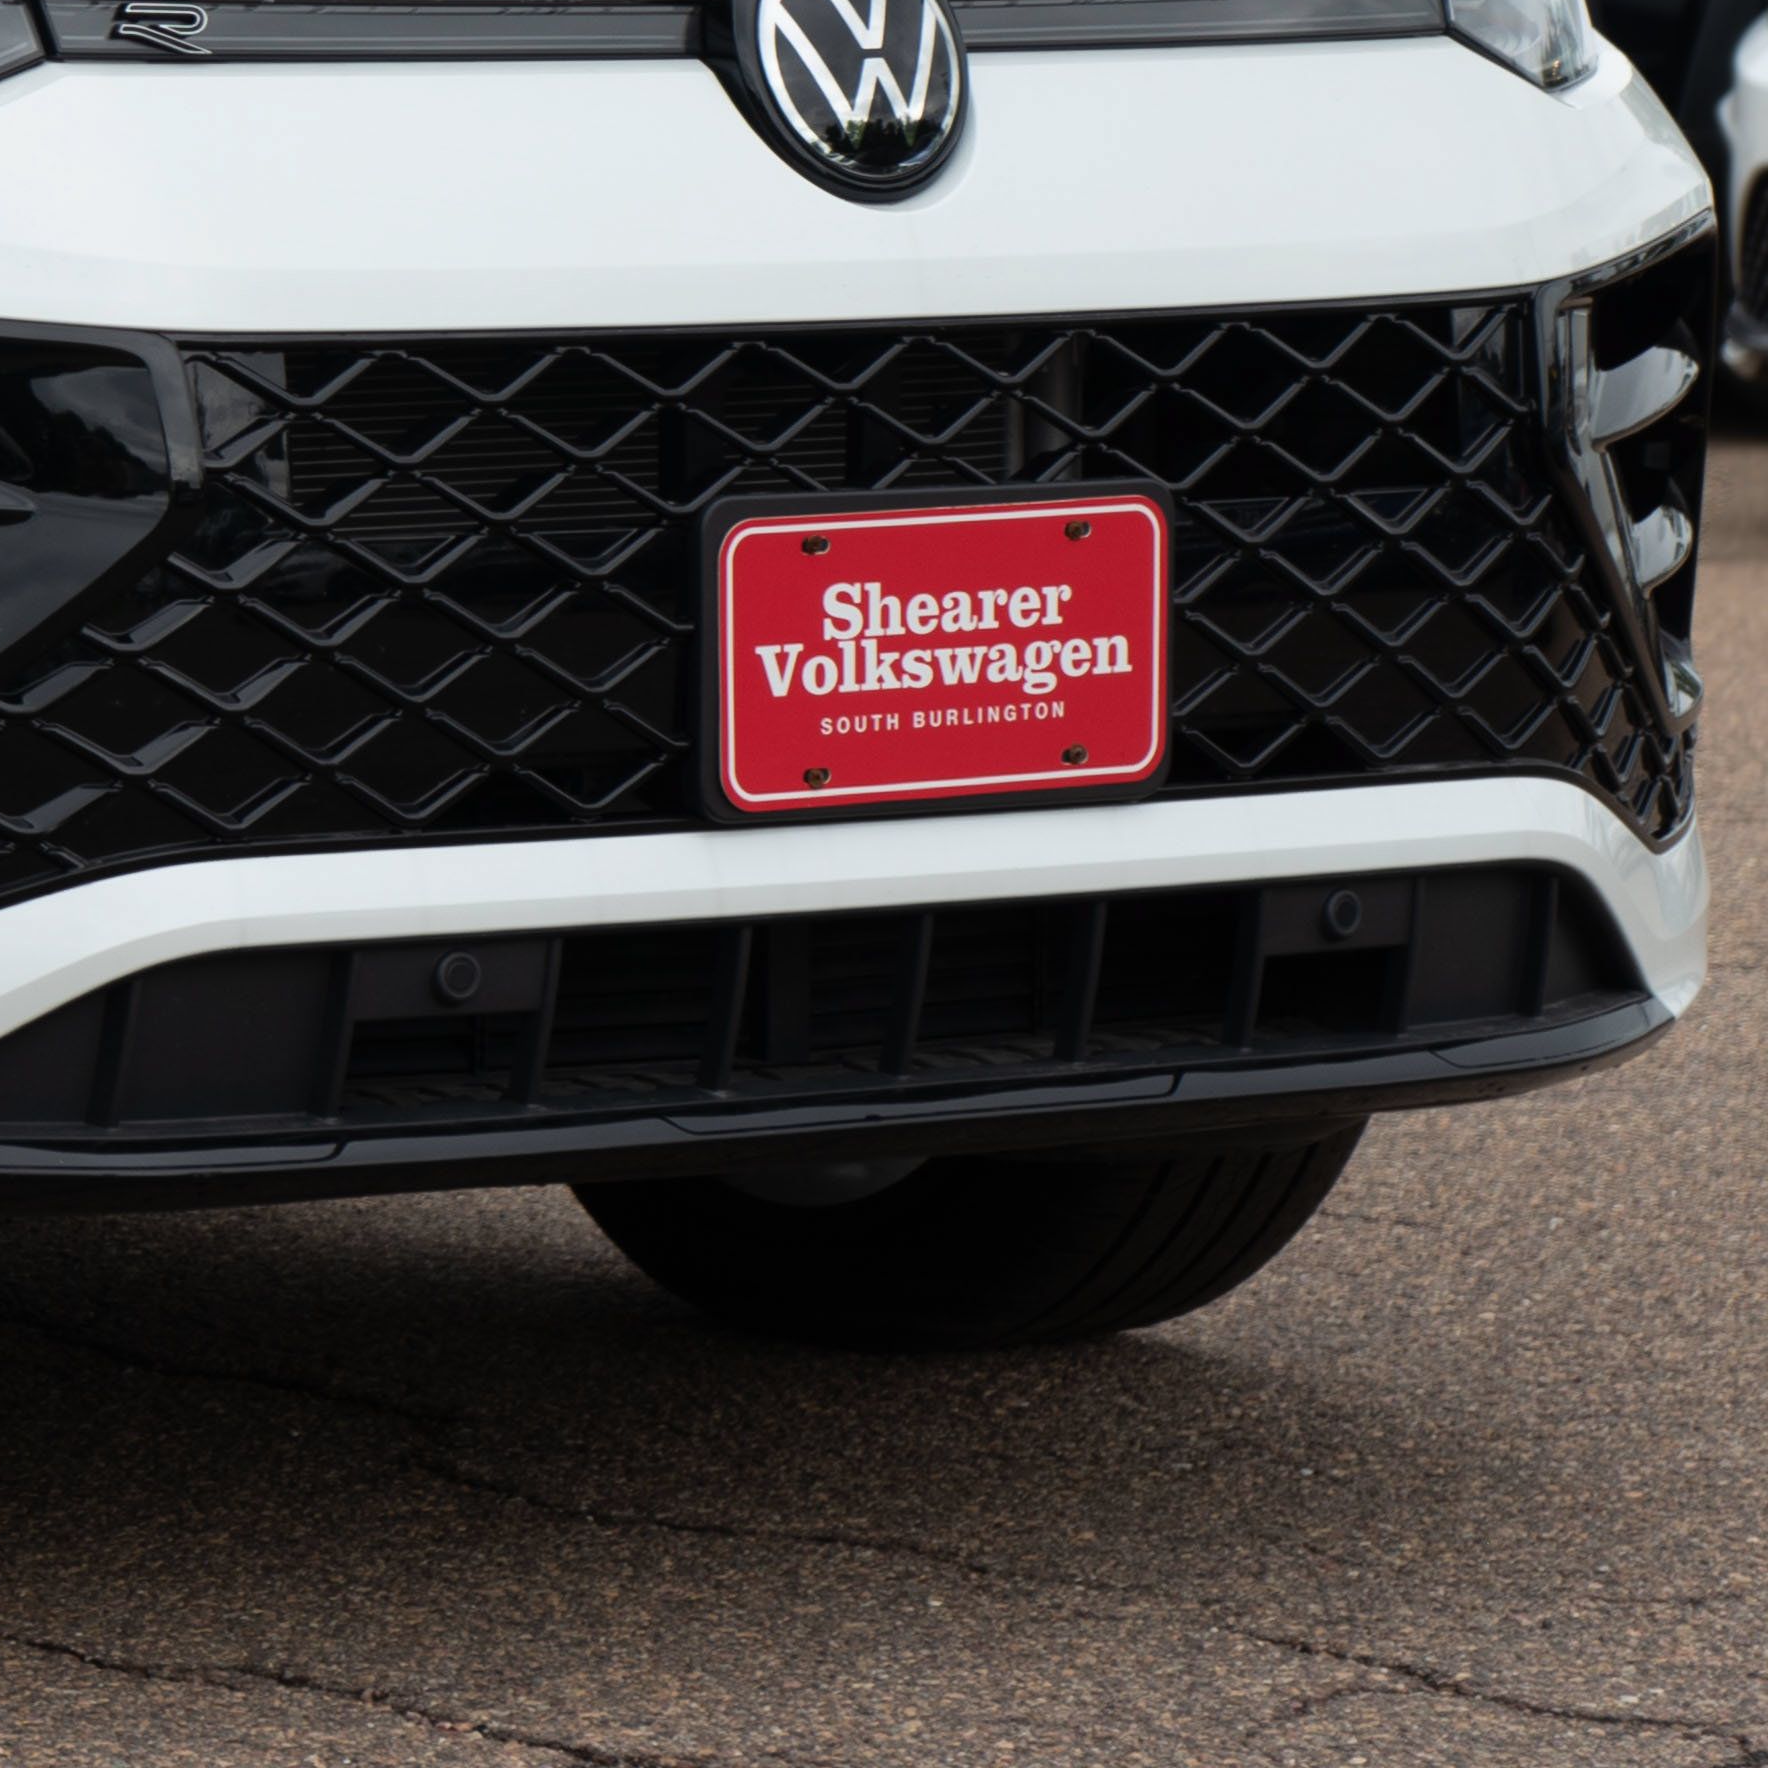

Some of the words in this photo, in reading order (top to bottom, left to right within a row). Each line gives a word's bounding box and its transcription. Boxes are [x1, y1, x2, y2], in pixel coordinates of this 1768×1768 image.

[116, 2, 213, 54] R
[822, 582, 1071, 641] Shearer
[755, 632, 1132, 698] Volkswagen
[820, 712, 900, 736] SOUTH
[913, 700, 1065, 729] BURLINGTON
